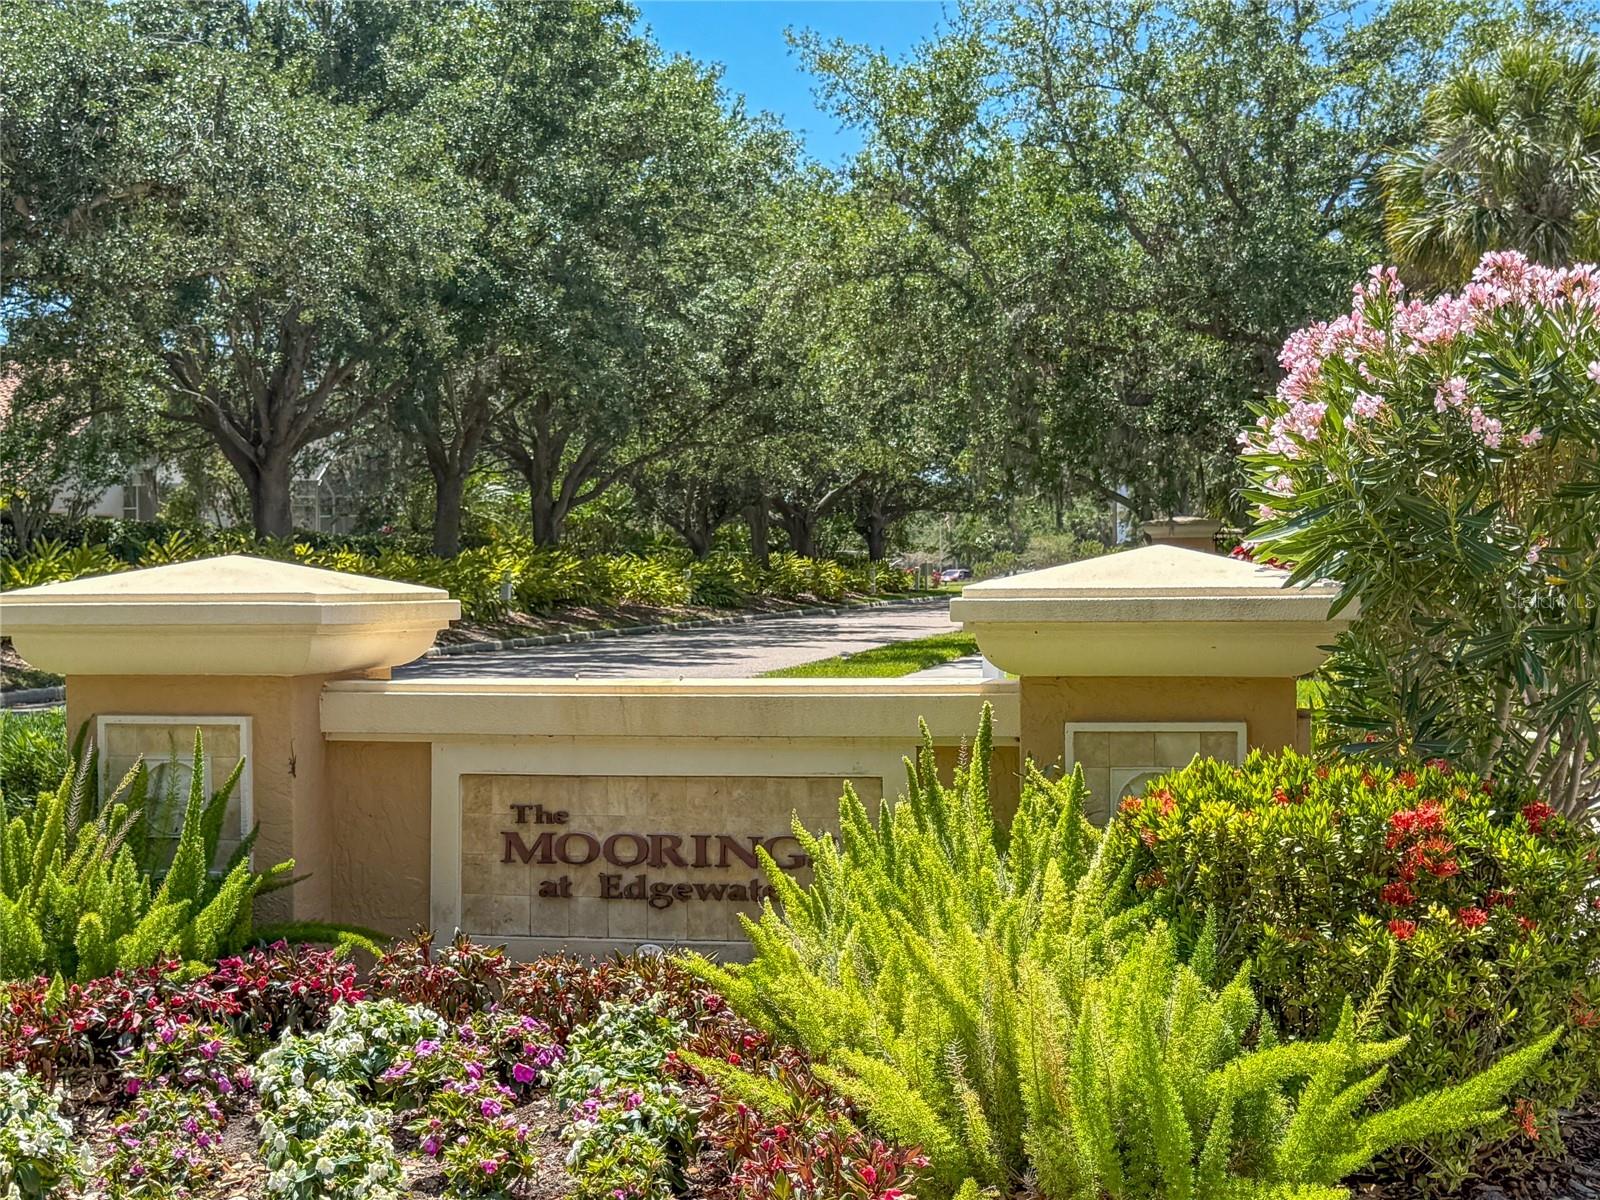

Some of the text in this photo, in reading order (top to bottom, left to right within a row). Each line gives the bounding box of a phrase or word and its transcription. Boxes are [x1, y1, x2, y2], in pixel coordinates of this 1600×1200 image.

[509, 804, 569, 825] The
[500, 831, 826, 870] MOORING
[538, 872, 780, 909] at Edgewate
